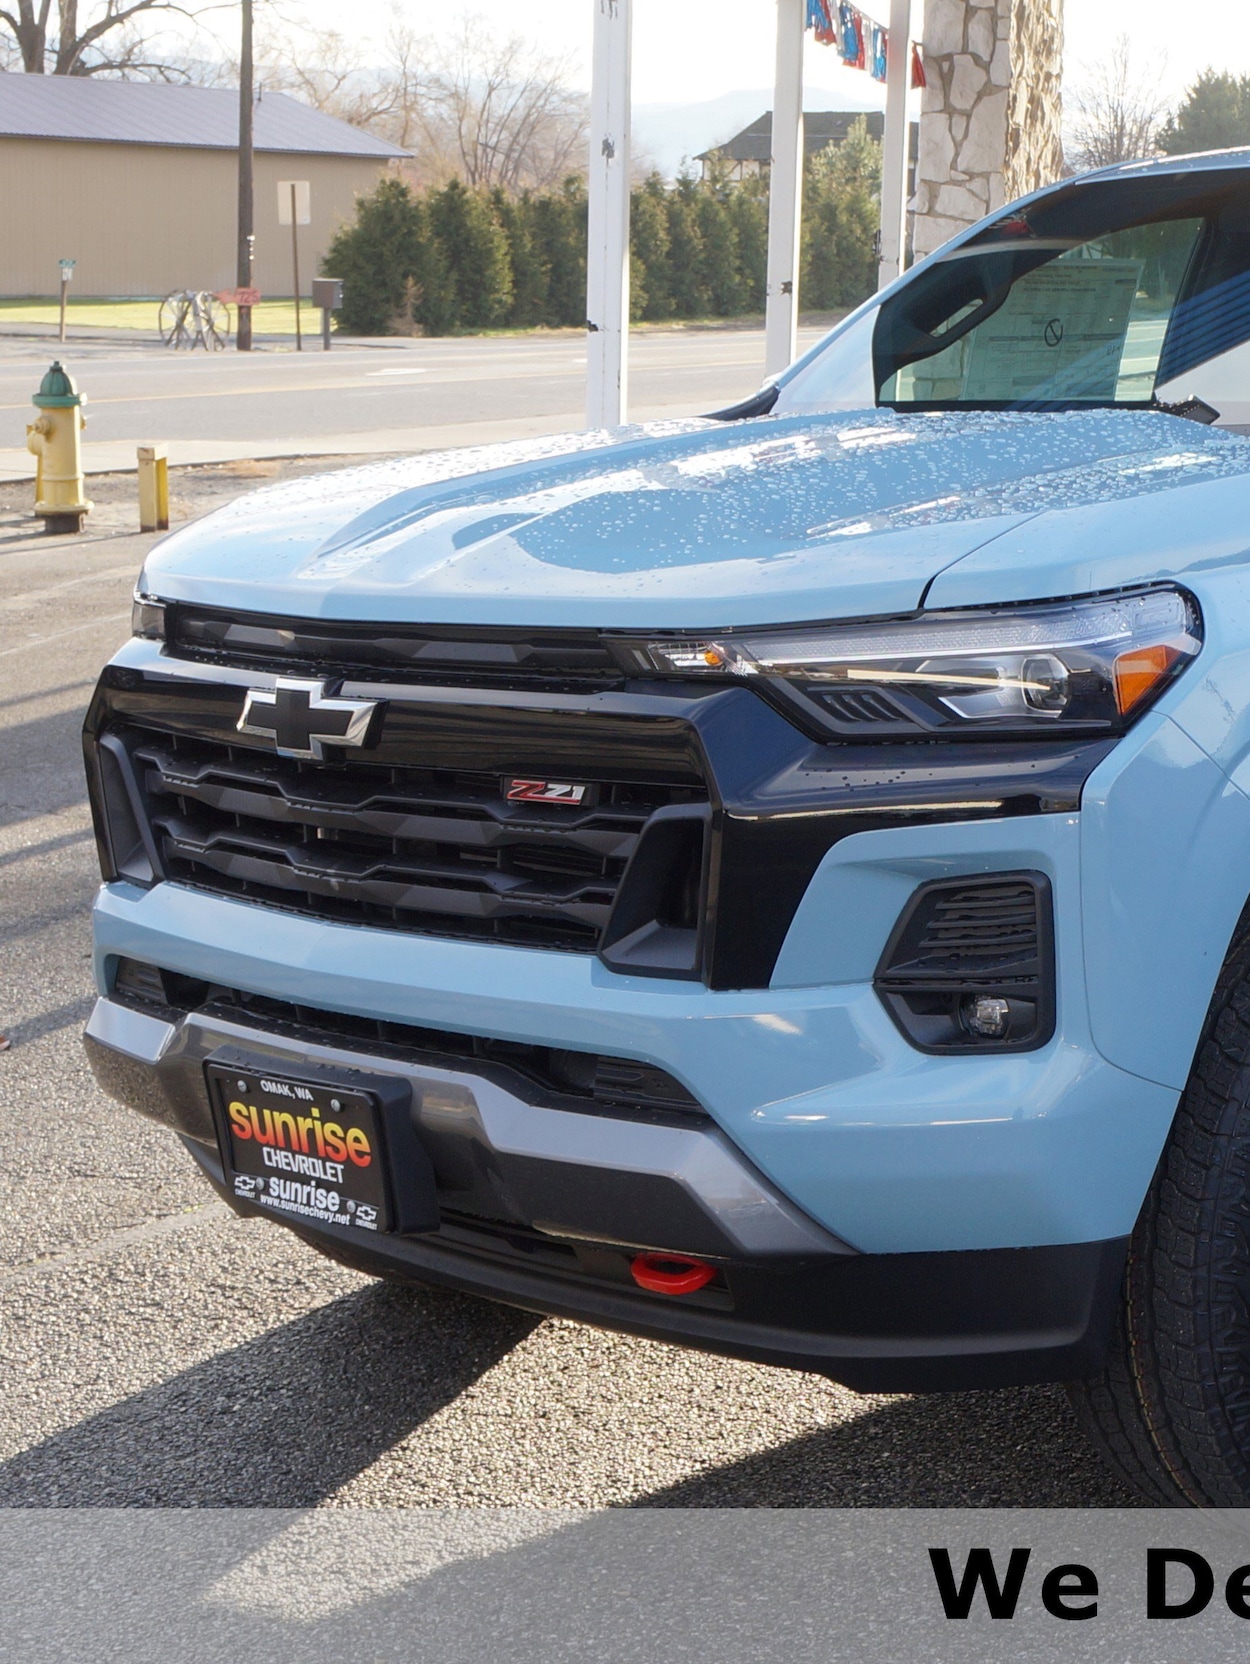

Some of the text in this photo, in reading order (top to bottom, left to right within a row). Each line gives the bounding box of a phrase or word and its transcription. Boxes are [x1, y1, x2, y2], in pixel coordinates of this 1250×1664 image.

[507, 780, 586, 805] Z71
[260, 1080, 314, 1101] OMAK, WA
[229, 1101, 372, 1168] sunrise
[262, 1147, 345, 1184] CHEVROLET
[260, 1194, 350, 1226] www.sunrisechevy.net
[269, 1176, 341, 1212] sunrise
